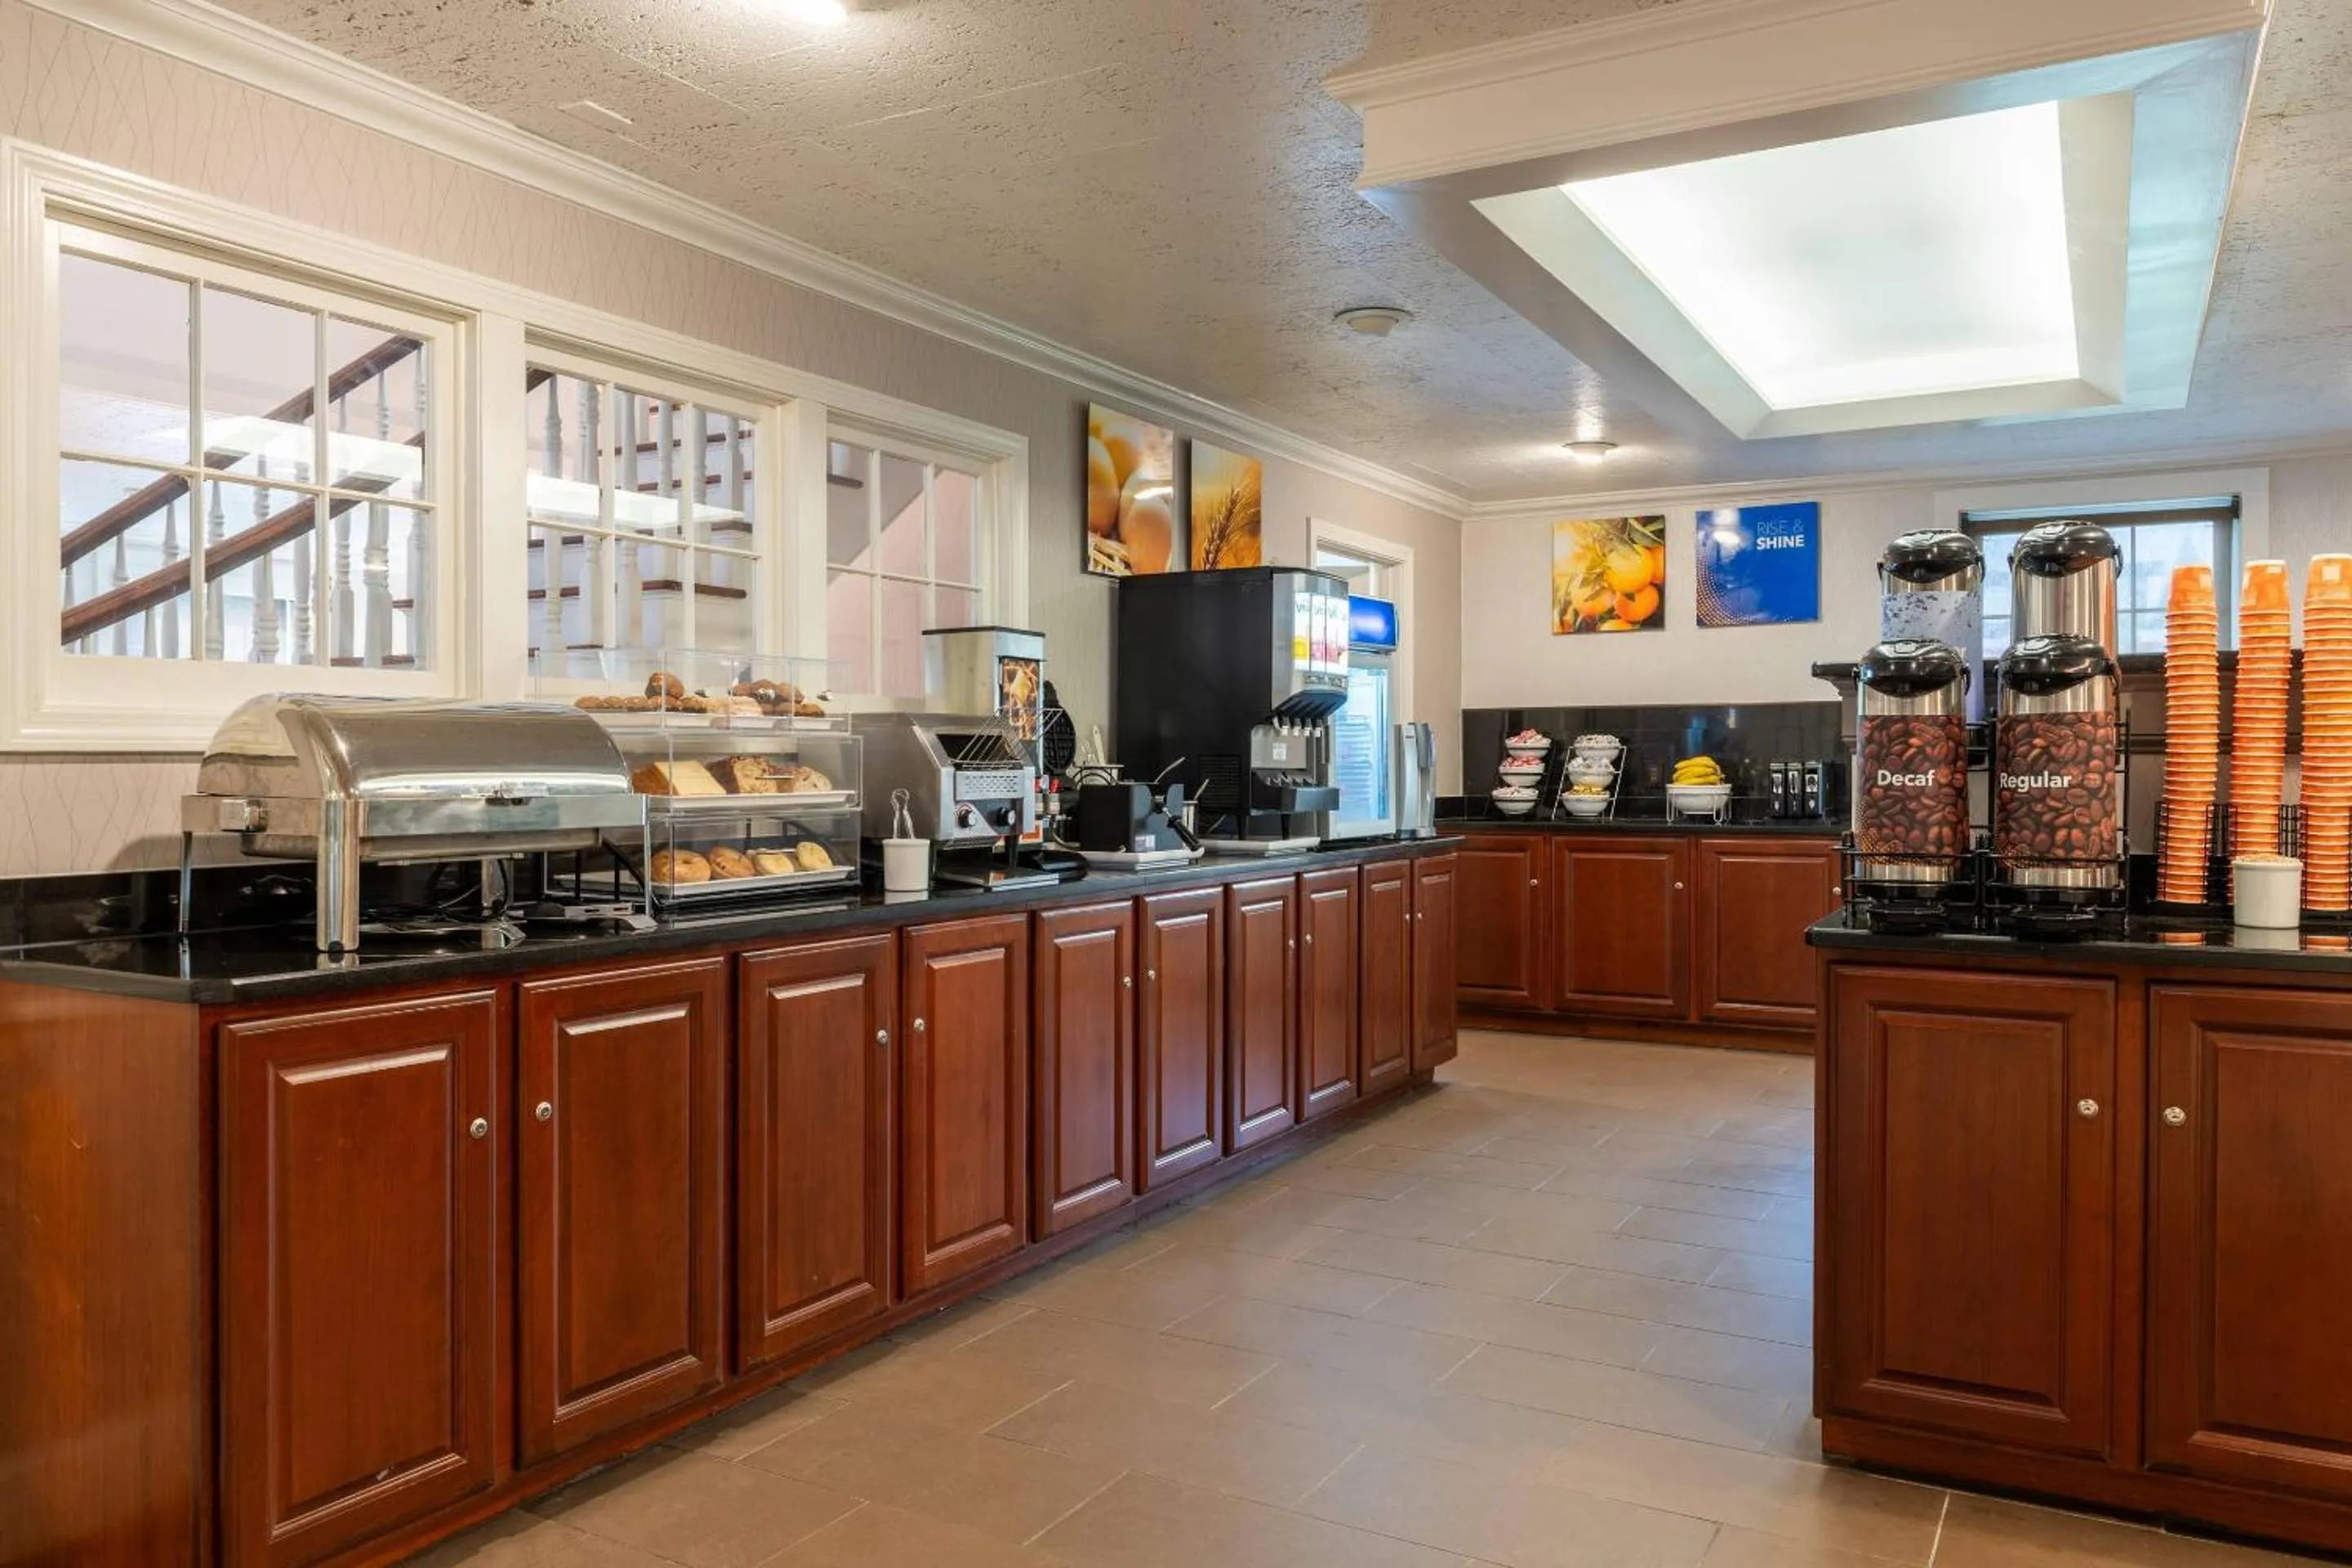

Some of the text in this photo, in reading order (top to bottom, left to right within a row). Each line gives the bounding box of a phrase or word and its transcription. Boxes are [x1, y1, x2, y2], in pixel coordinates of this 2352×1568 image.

[1757, 518, 1804, 536] RISE &
[1756, 534, 1805, 550] SHINE
[1877, 769, 1936, 786] Decaf
[2000, 770, 2072, 793] Regular
